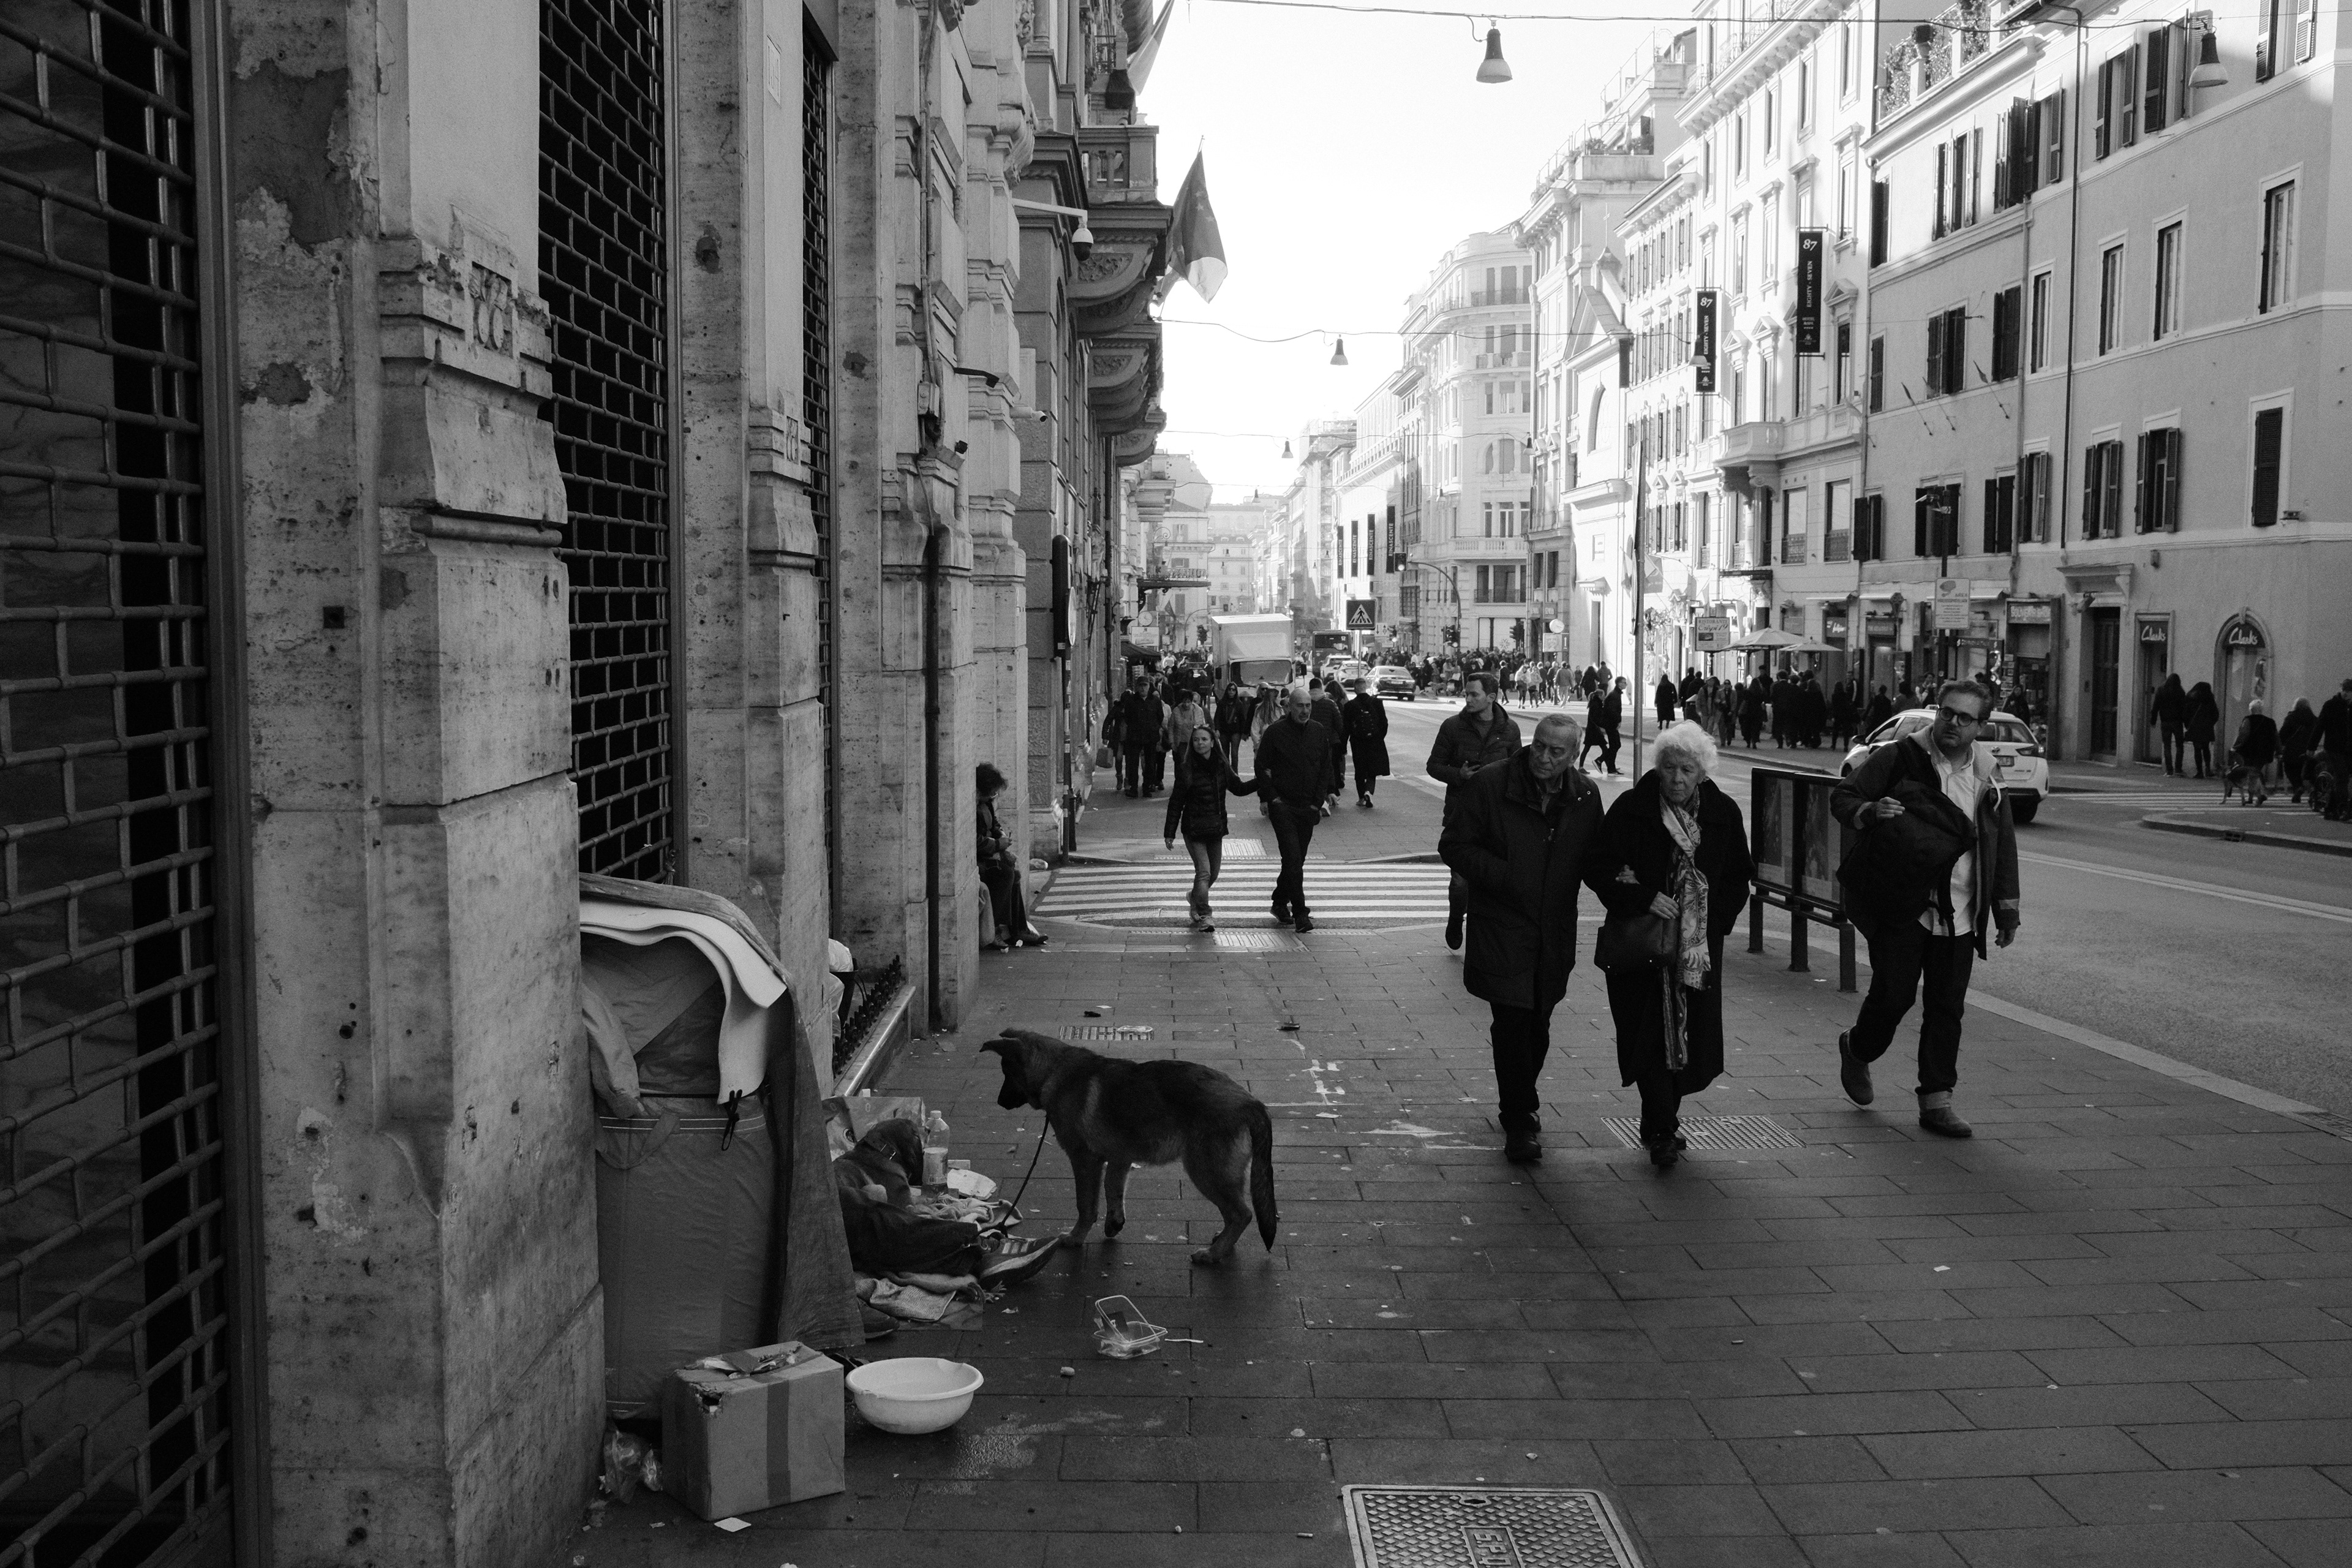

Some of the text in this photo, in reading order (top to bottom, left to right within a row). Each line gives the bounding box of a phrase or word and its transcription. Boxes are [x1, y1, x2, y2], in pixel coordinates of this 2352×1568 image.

[1803, 239, 1818, 252] 87
[1700, 297, 1713, 308] 87
[2141, 625, 2166, 642] Clarks
[2229, 627, 2258, 645] Clarks
